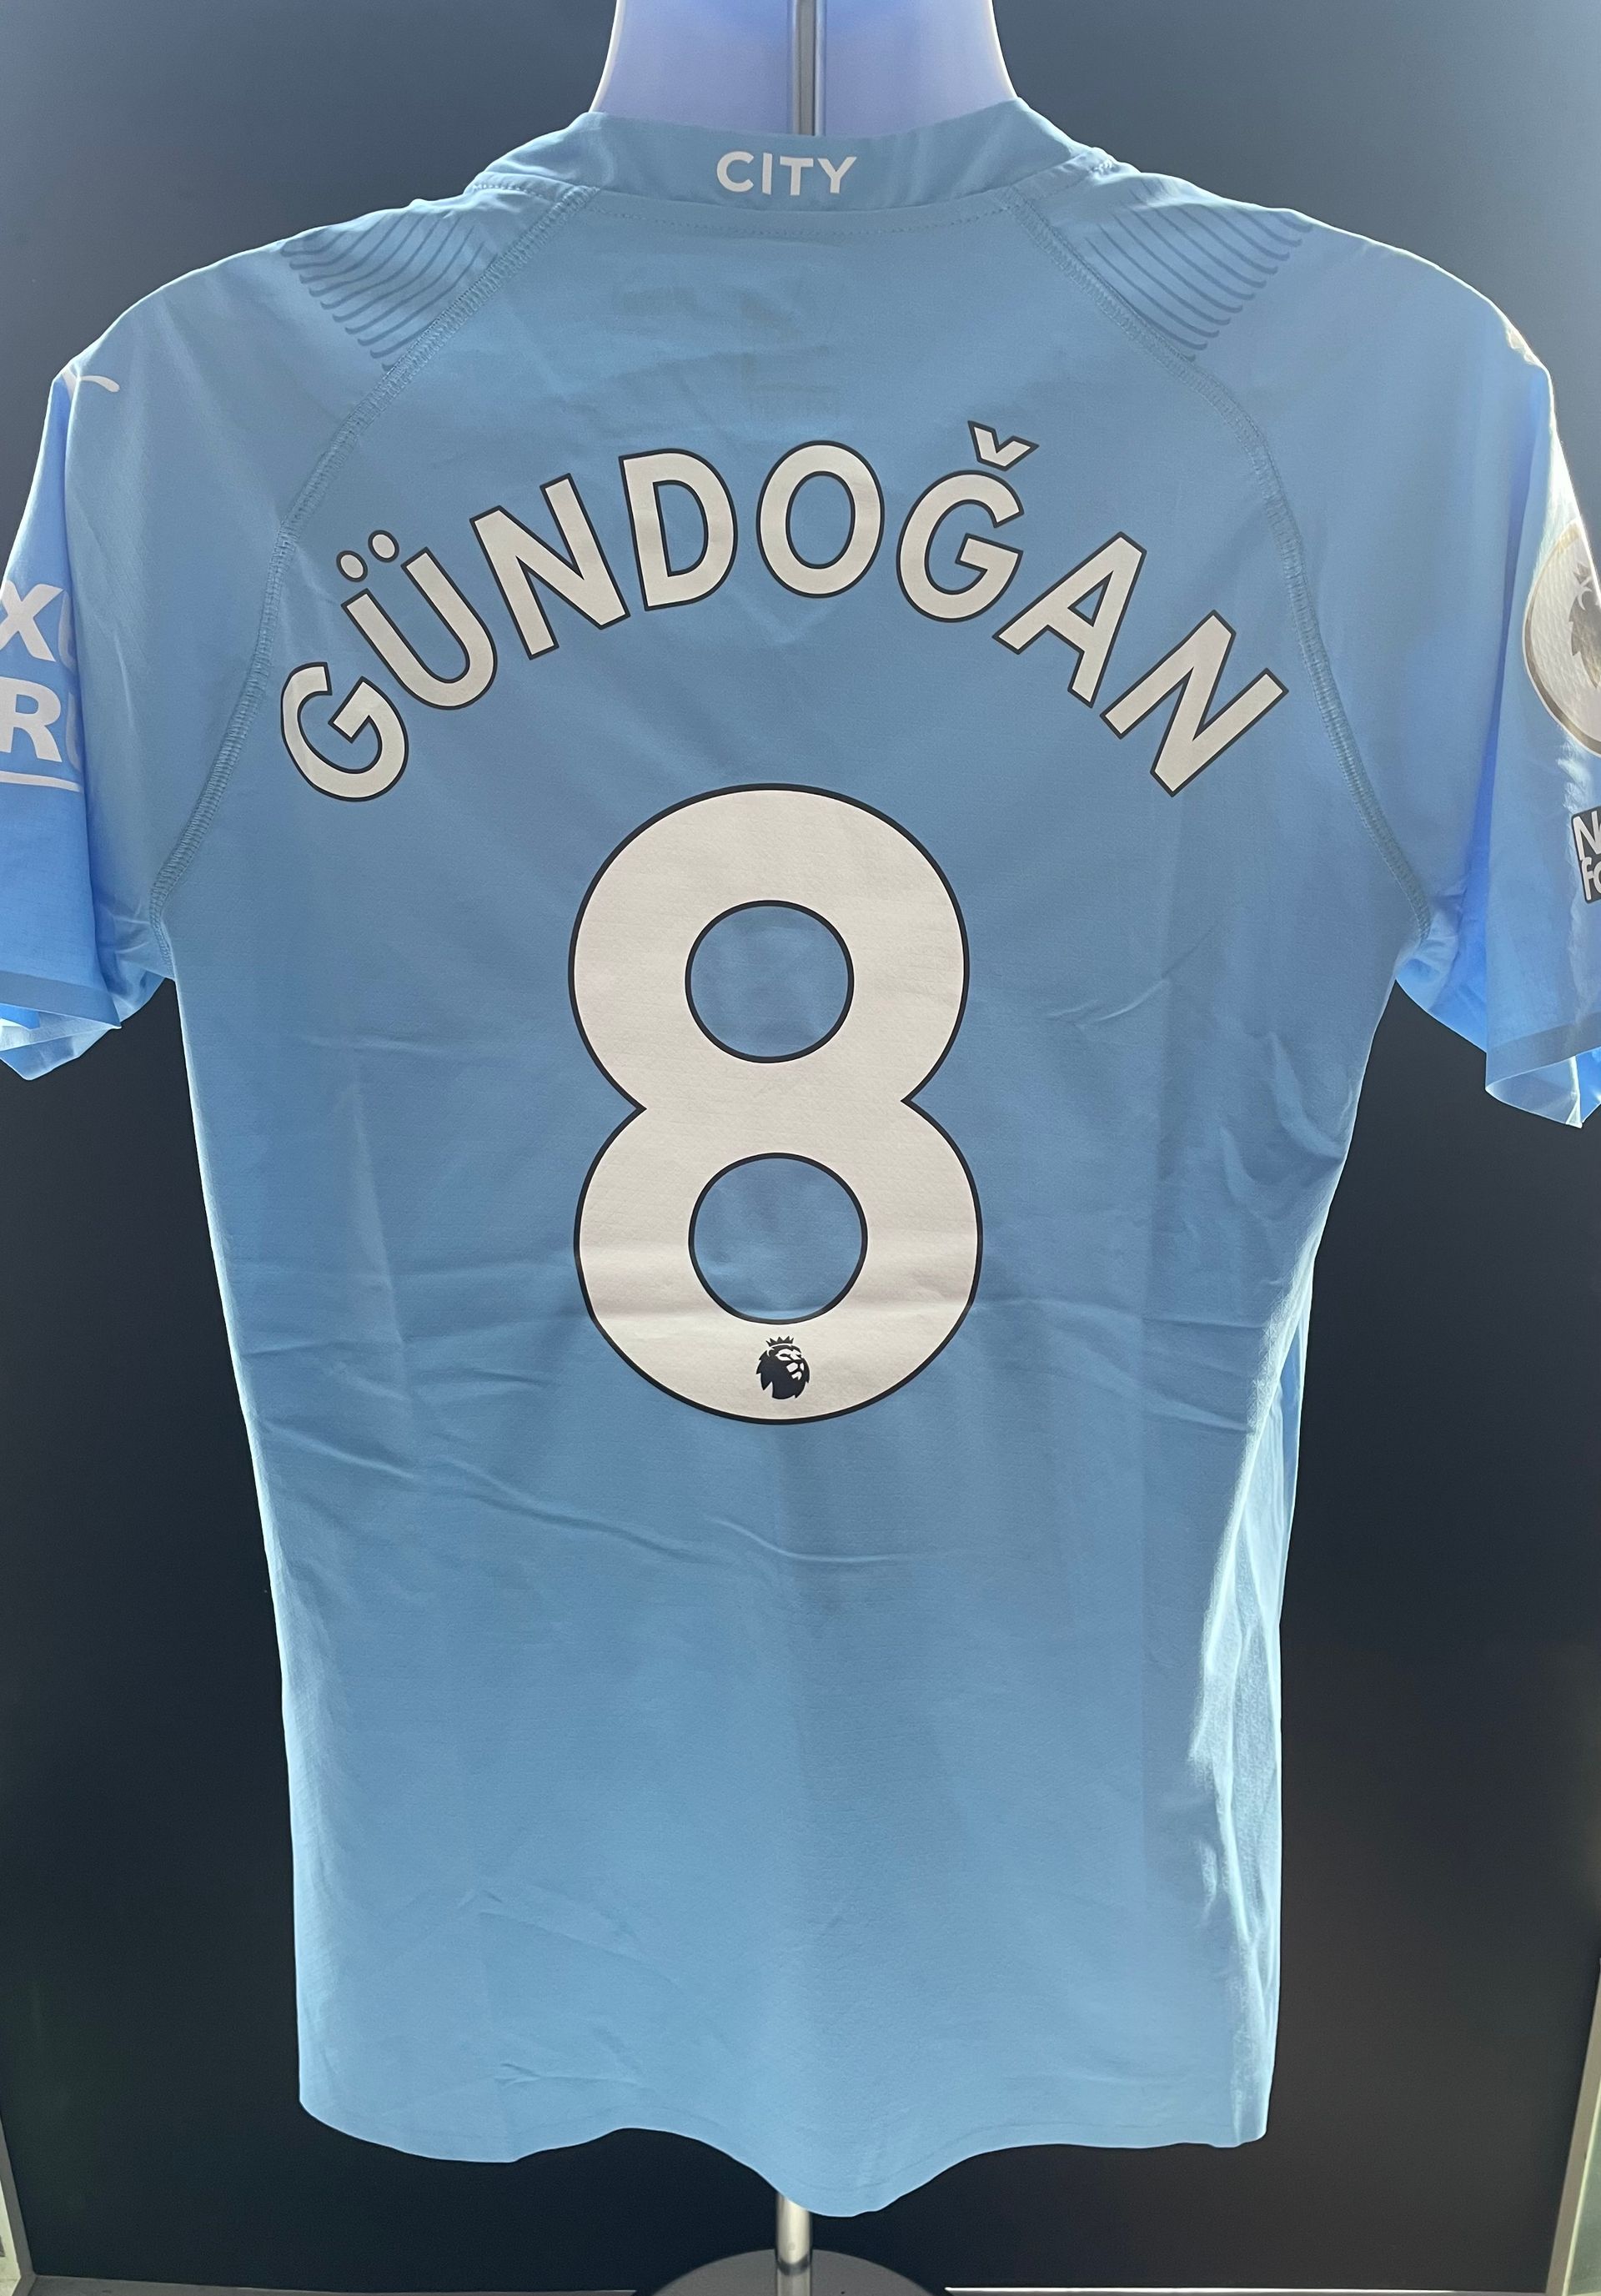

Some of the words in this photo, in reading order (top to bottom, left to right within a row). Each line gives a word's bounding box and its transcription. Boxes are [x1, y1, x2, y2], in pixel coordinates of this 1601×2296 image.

[716, 151, 857, 196] CITY
[0, 580, 78, 674] X
[0, 675, 82, 772] R
[568, 783, 983, 1425] 8
